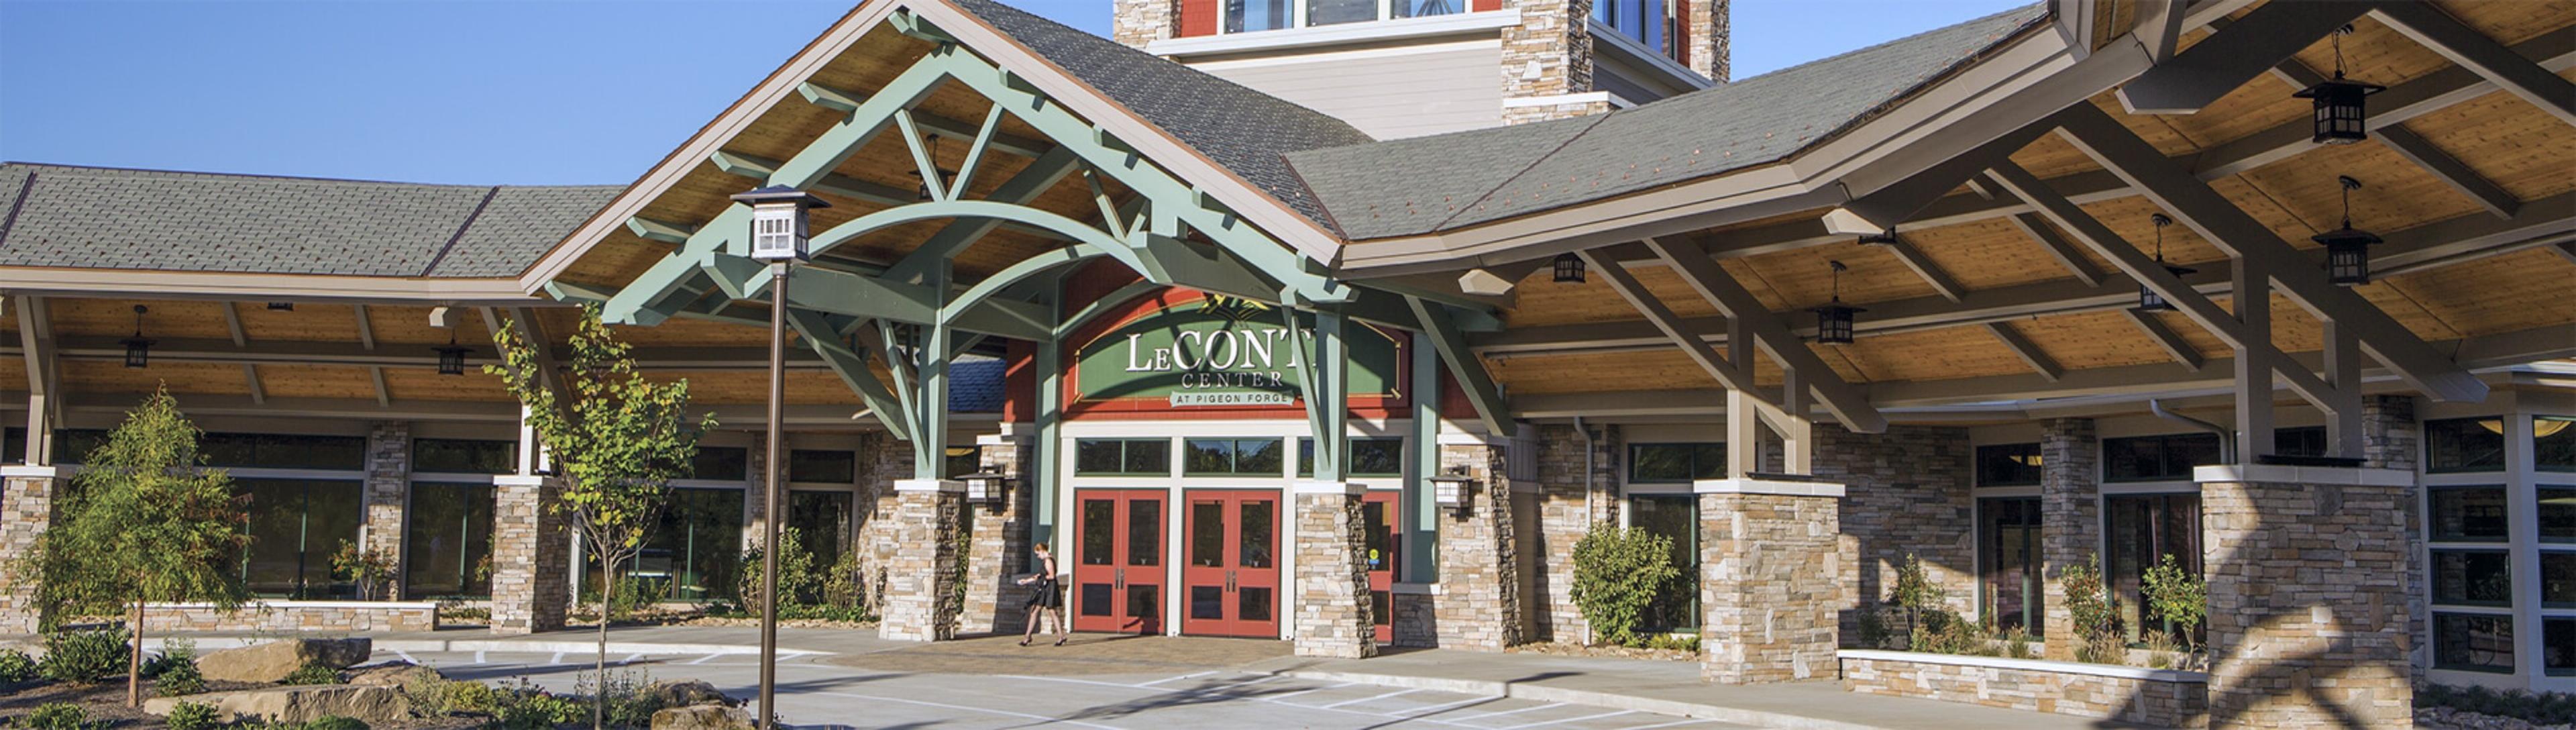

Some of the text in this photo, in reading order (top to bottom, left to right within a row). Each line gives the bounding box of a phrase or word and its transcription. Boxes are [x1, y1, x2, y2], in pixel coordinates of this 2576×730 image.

[1126, 329, 1317, 371] LECONT
[1181, 371, 1283, 388] CENTER
[1177, 394, 1287, 403] AT PIGEON FORGE
